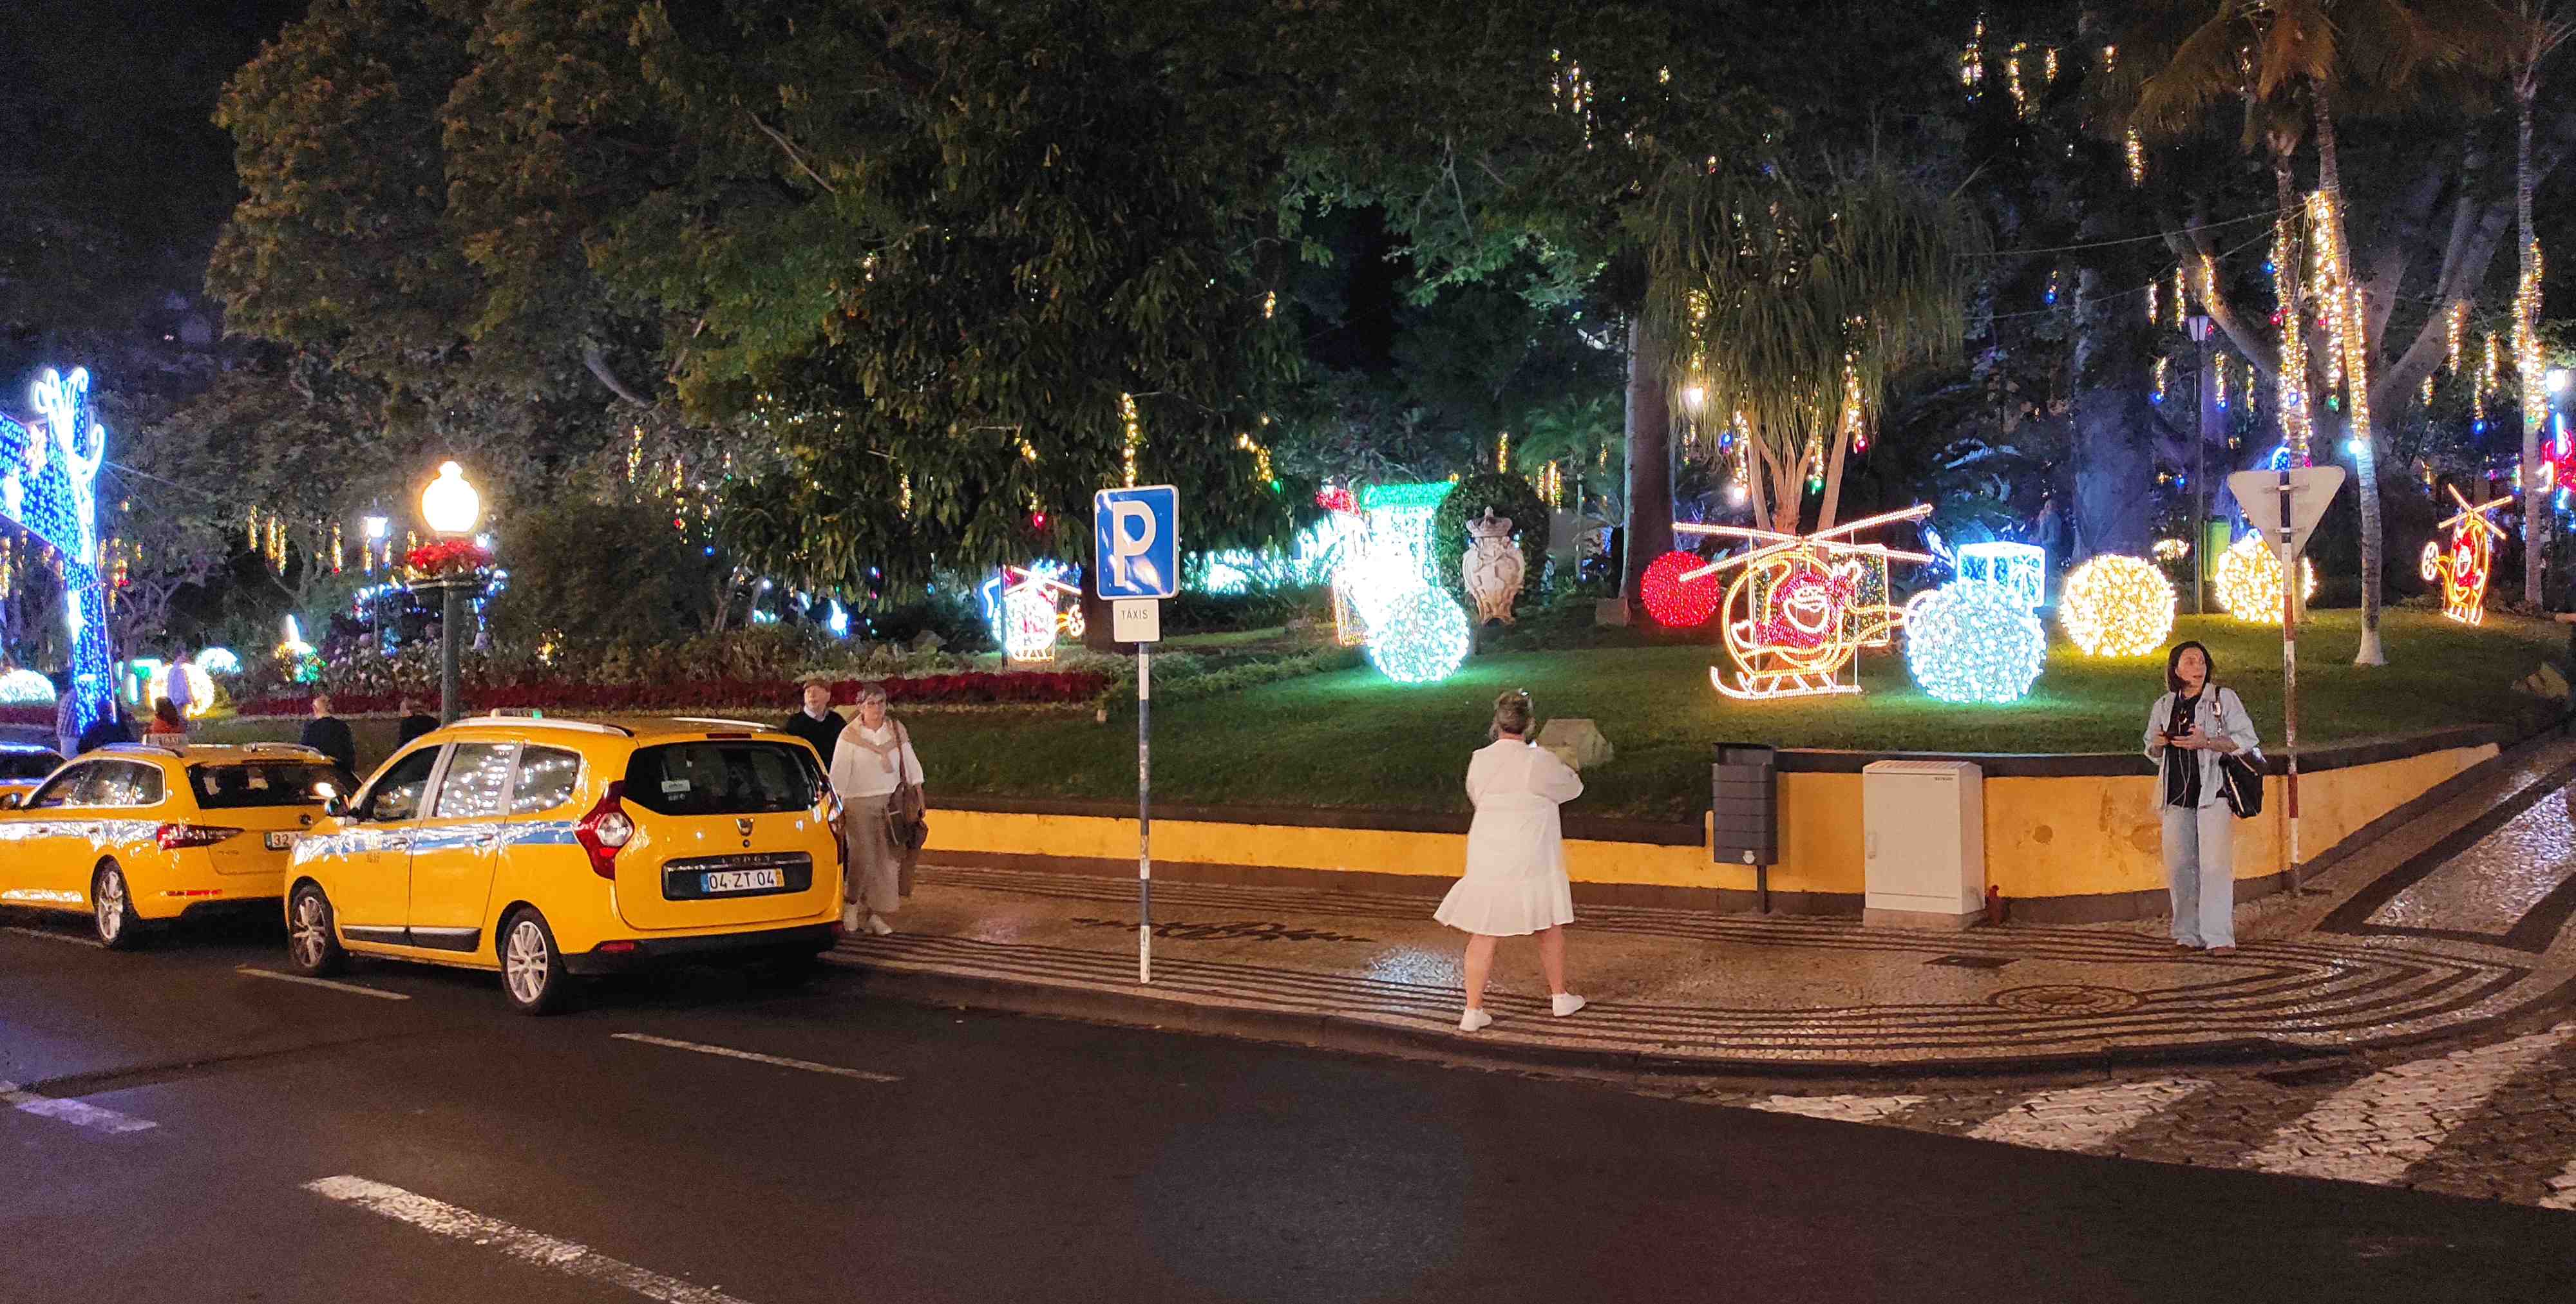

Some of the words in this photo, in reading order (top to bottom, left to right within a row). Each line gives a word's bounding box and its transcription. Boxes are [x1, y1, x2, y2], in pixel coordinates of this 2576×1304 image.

[1112, 500, 1157, 587] P
[1121, 608, 1148, 619] TÁXIS
[709, 874, 727, 889] 04
[732, 873, 751, 887] ZT
[757, 871, 774, 887] 04
